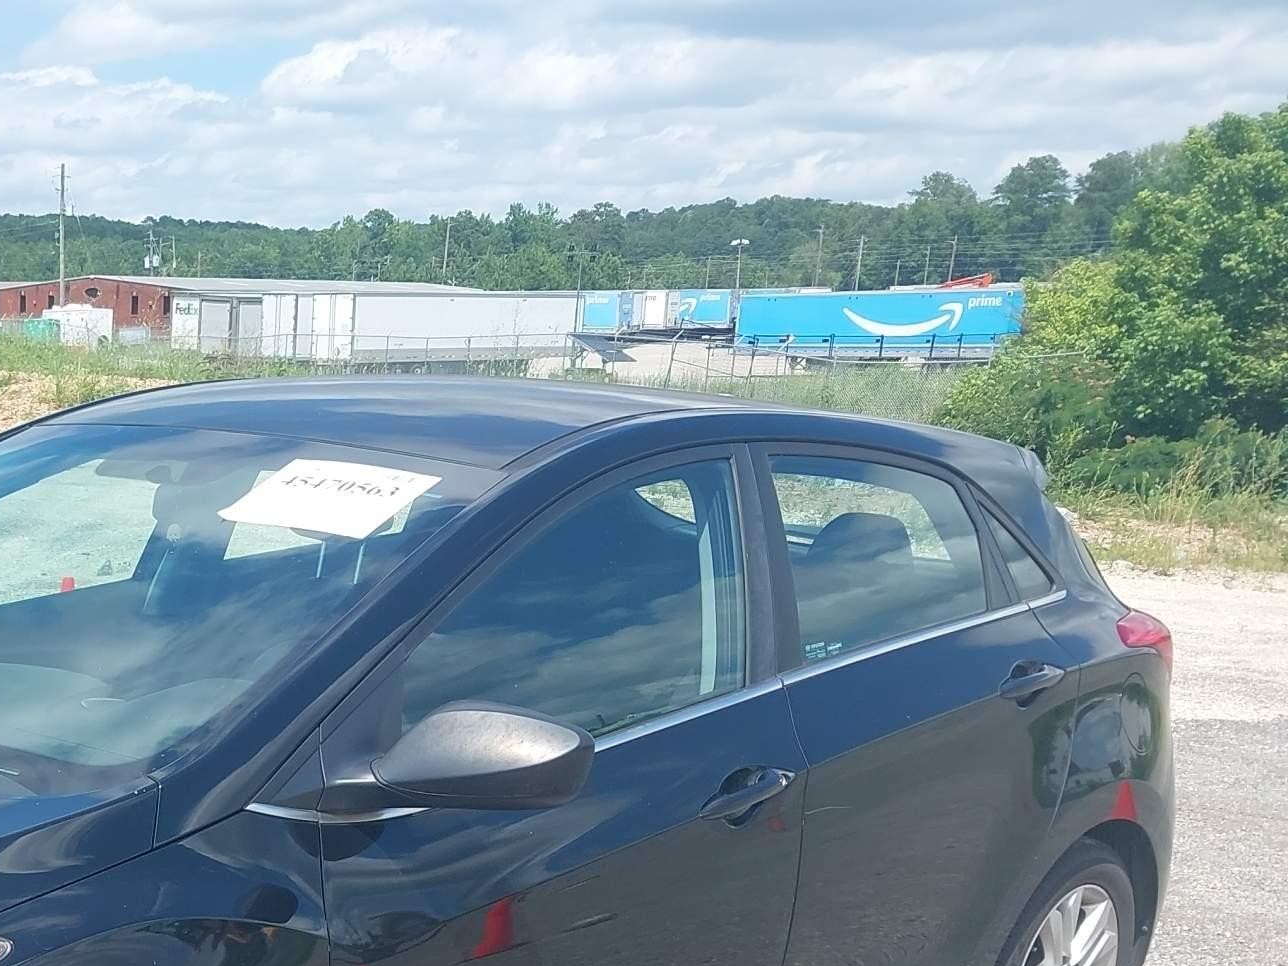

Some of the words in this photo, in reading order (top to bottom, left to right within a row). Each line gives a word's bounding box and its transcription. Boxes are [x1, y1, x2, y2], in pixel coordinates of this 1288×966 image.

[175, 302, 198, 315] FedEx
[968, 294, 1002, 309] prime
[281, 476, 400, 497] 45470563
